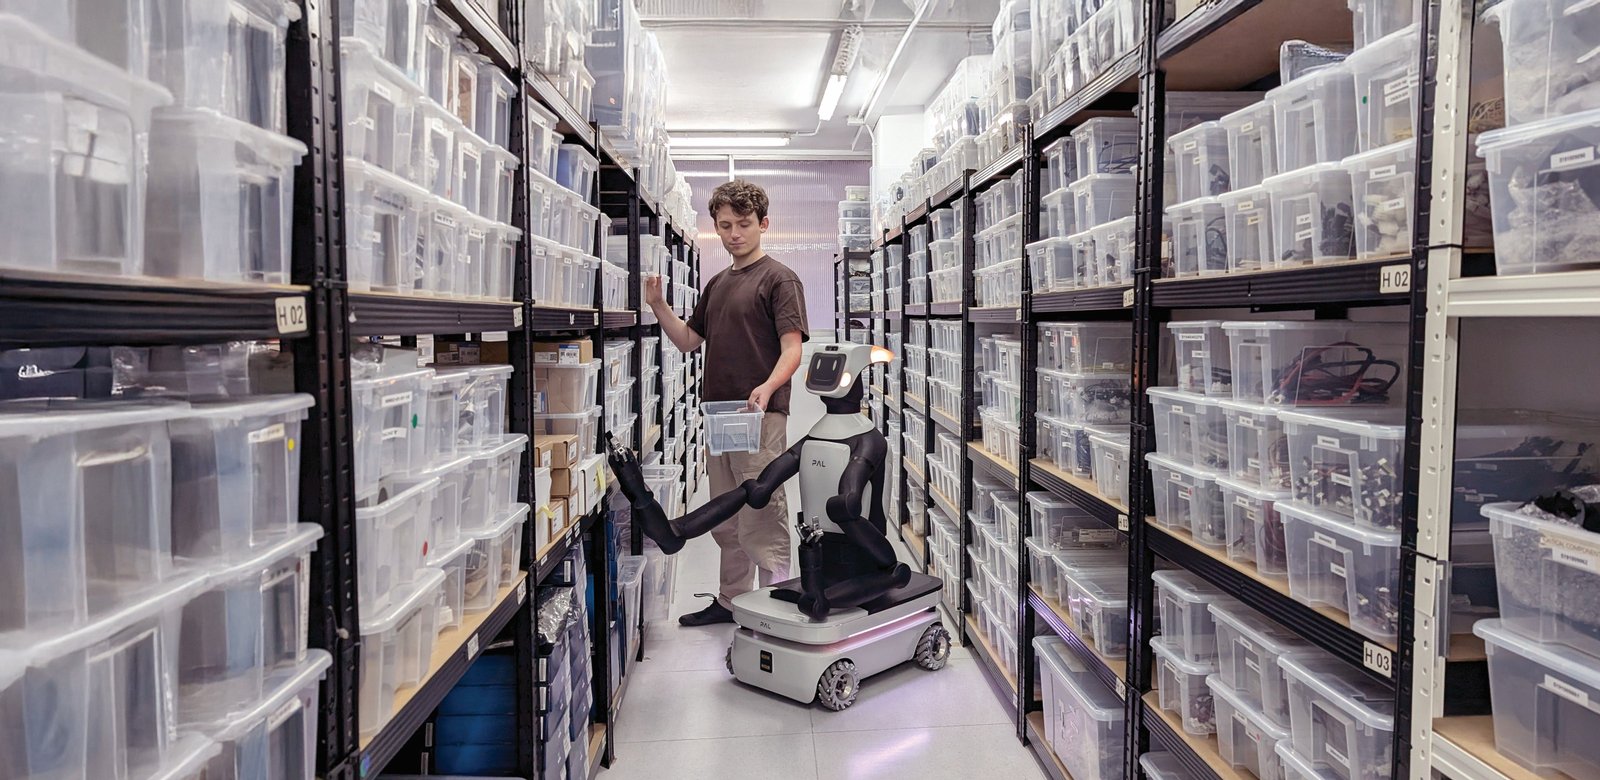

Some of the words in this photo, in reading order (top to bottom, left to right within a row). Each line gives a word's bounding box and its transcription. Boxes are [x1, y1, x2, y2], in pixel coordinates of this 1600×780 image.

[1382, 271, 1390, 288] H
[1395, 270, 1408, 287] 02
[278, 306, 287, 327] H
[290, 304, 303, 325] 02
[812, 459, 826, 468] PAL
[760, 620, 771, 630] PAL
[1365, 647, 1373, 665] H
[1376, 652, 1390, 671] 03
